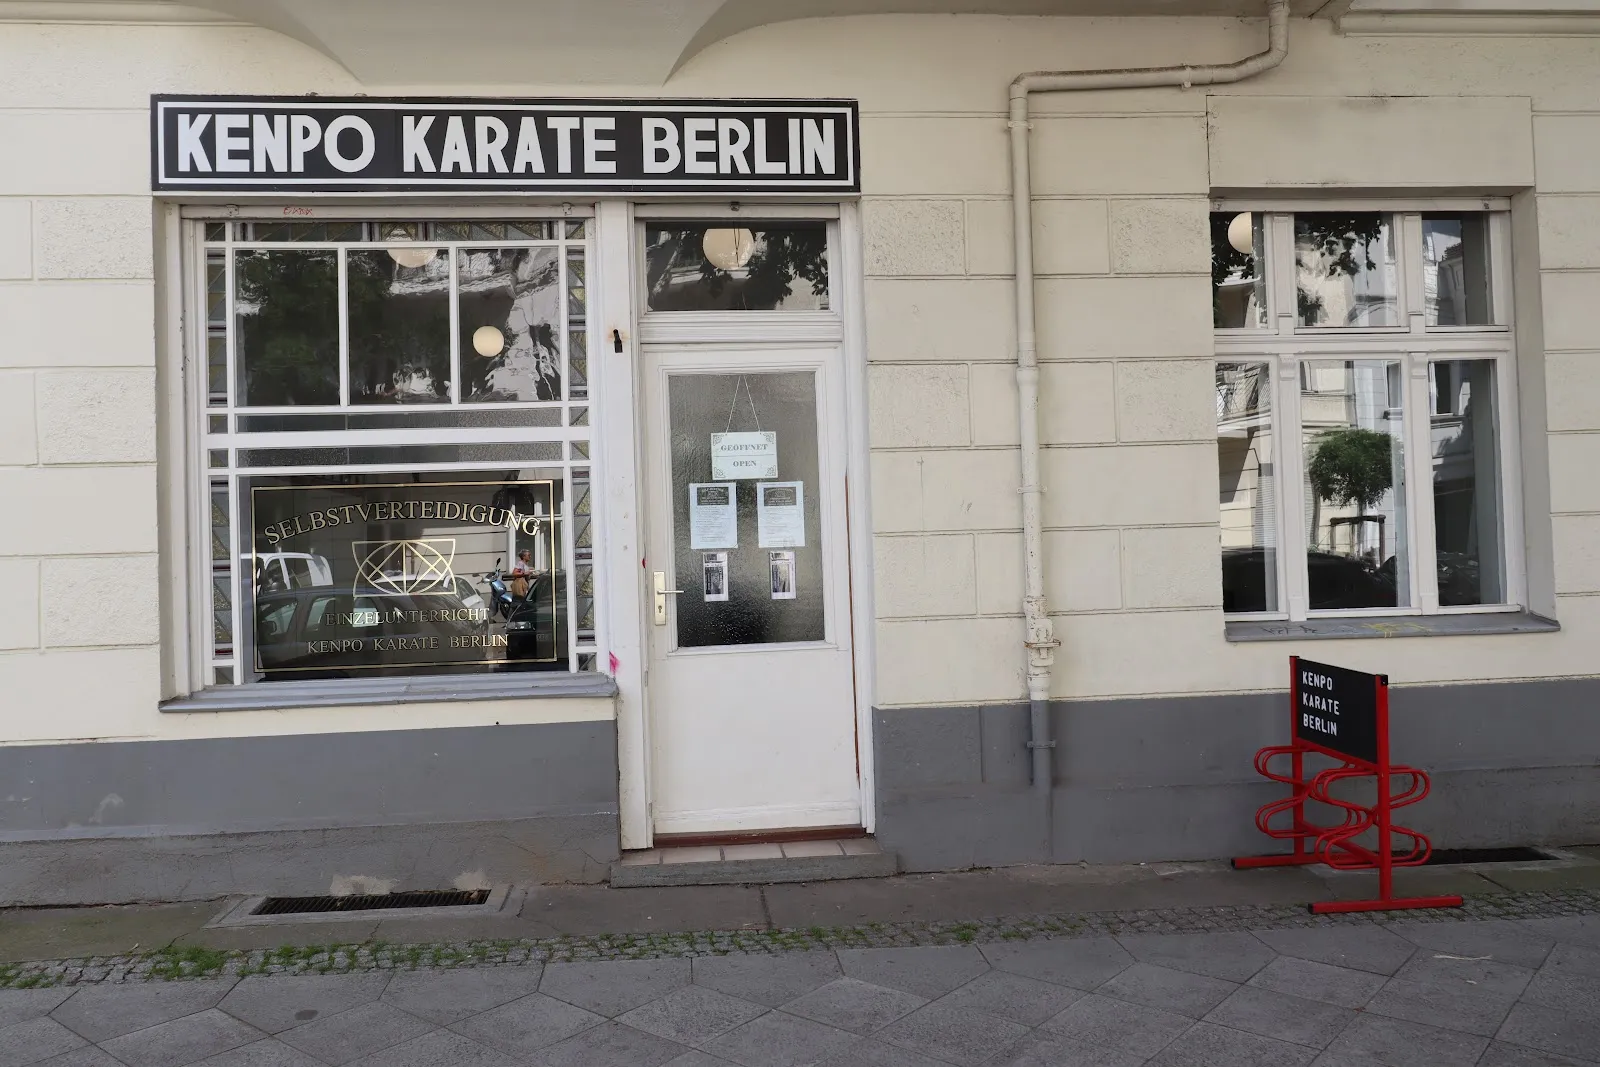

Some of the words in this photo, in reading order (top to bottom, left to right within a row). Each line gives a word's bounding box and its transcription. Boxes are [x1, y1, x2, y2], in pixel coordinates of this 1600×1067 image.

[177, 113, 375, 173] KENPO
[402, 115, 618, 174] KARATE
[641, 117, 836, 175] BERLIN
[732, 460, 757, 468] OPEN
[264, 500, 542, 545] SELBSTVERTEIDIGUNG
[325, 607, 490, 626] EINZELUNTERRICHT
[307, 639, 363, 654] KENPO
[373, 636, 439, 651] KARATE
[450, 634, 509, 648] BERLIN
[1302, 671, 1333, 691] KENPO
[1302, 692, 1340, 716] KARATE
[1303, 713, 1338, 736] BERLIN
